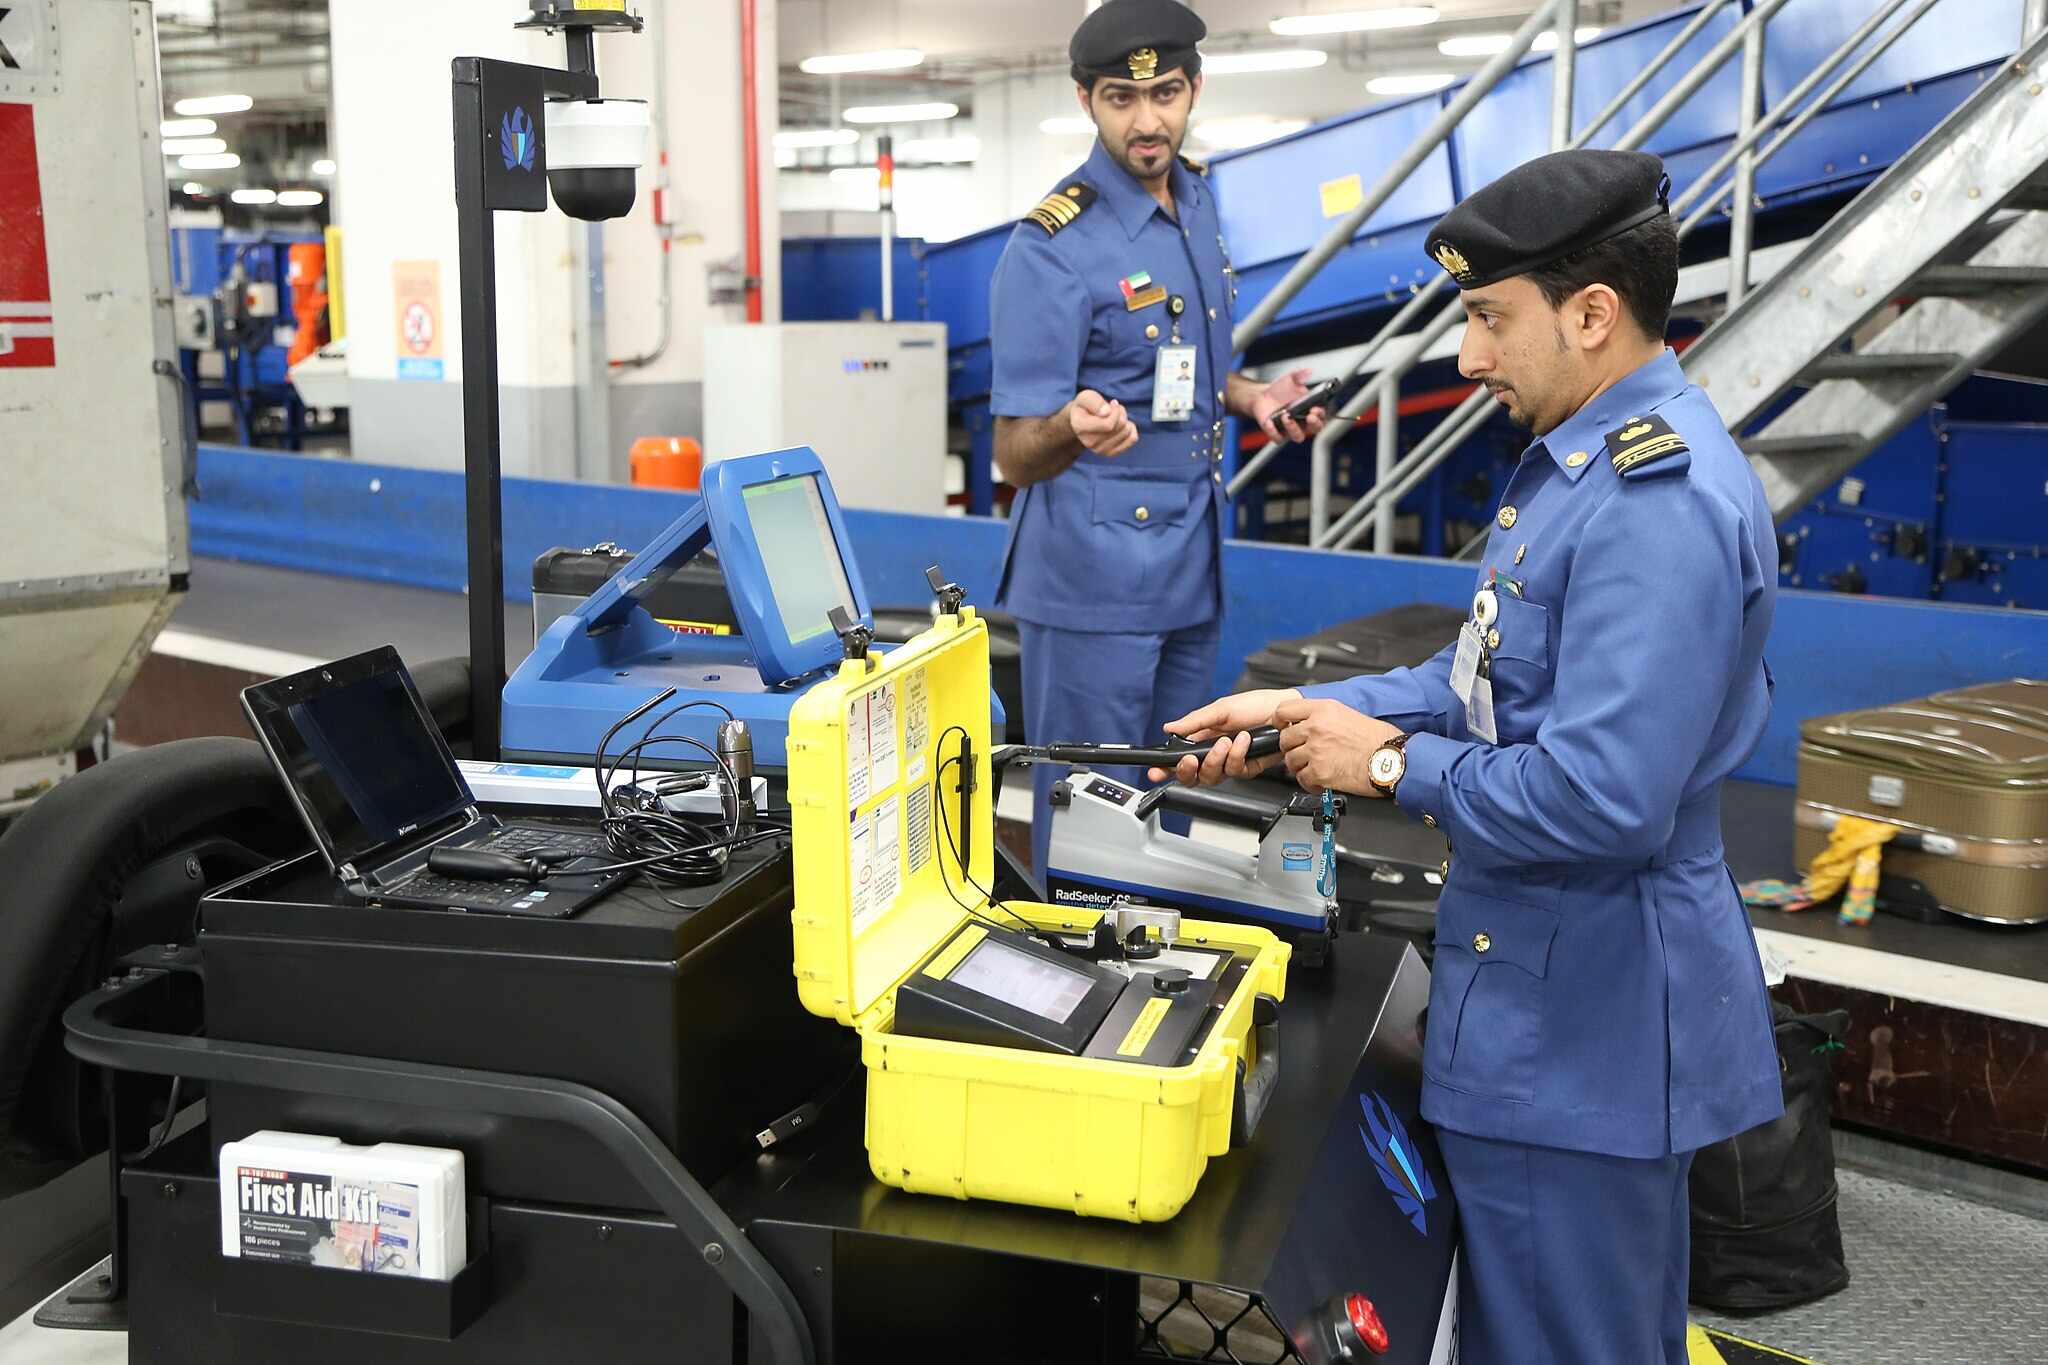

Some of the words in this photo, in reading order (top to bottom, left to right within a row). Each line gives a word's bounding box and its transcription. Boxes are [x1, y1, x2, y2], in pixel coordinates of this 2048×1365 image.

[241, 1176, 296, 1215] First
[300, 1182, 339, 1220] Aid
[345, 1186, 380, 1225] Kit
[257, 1237, 281, 1247] pieces
